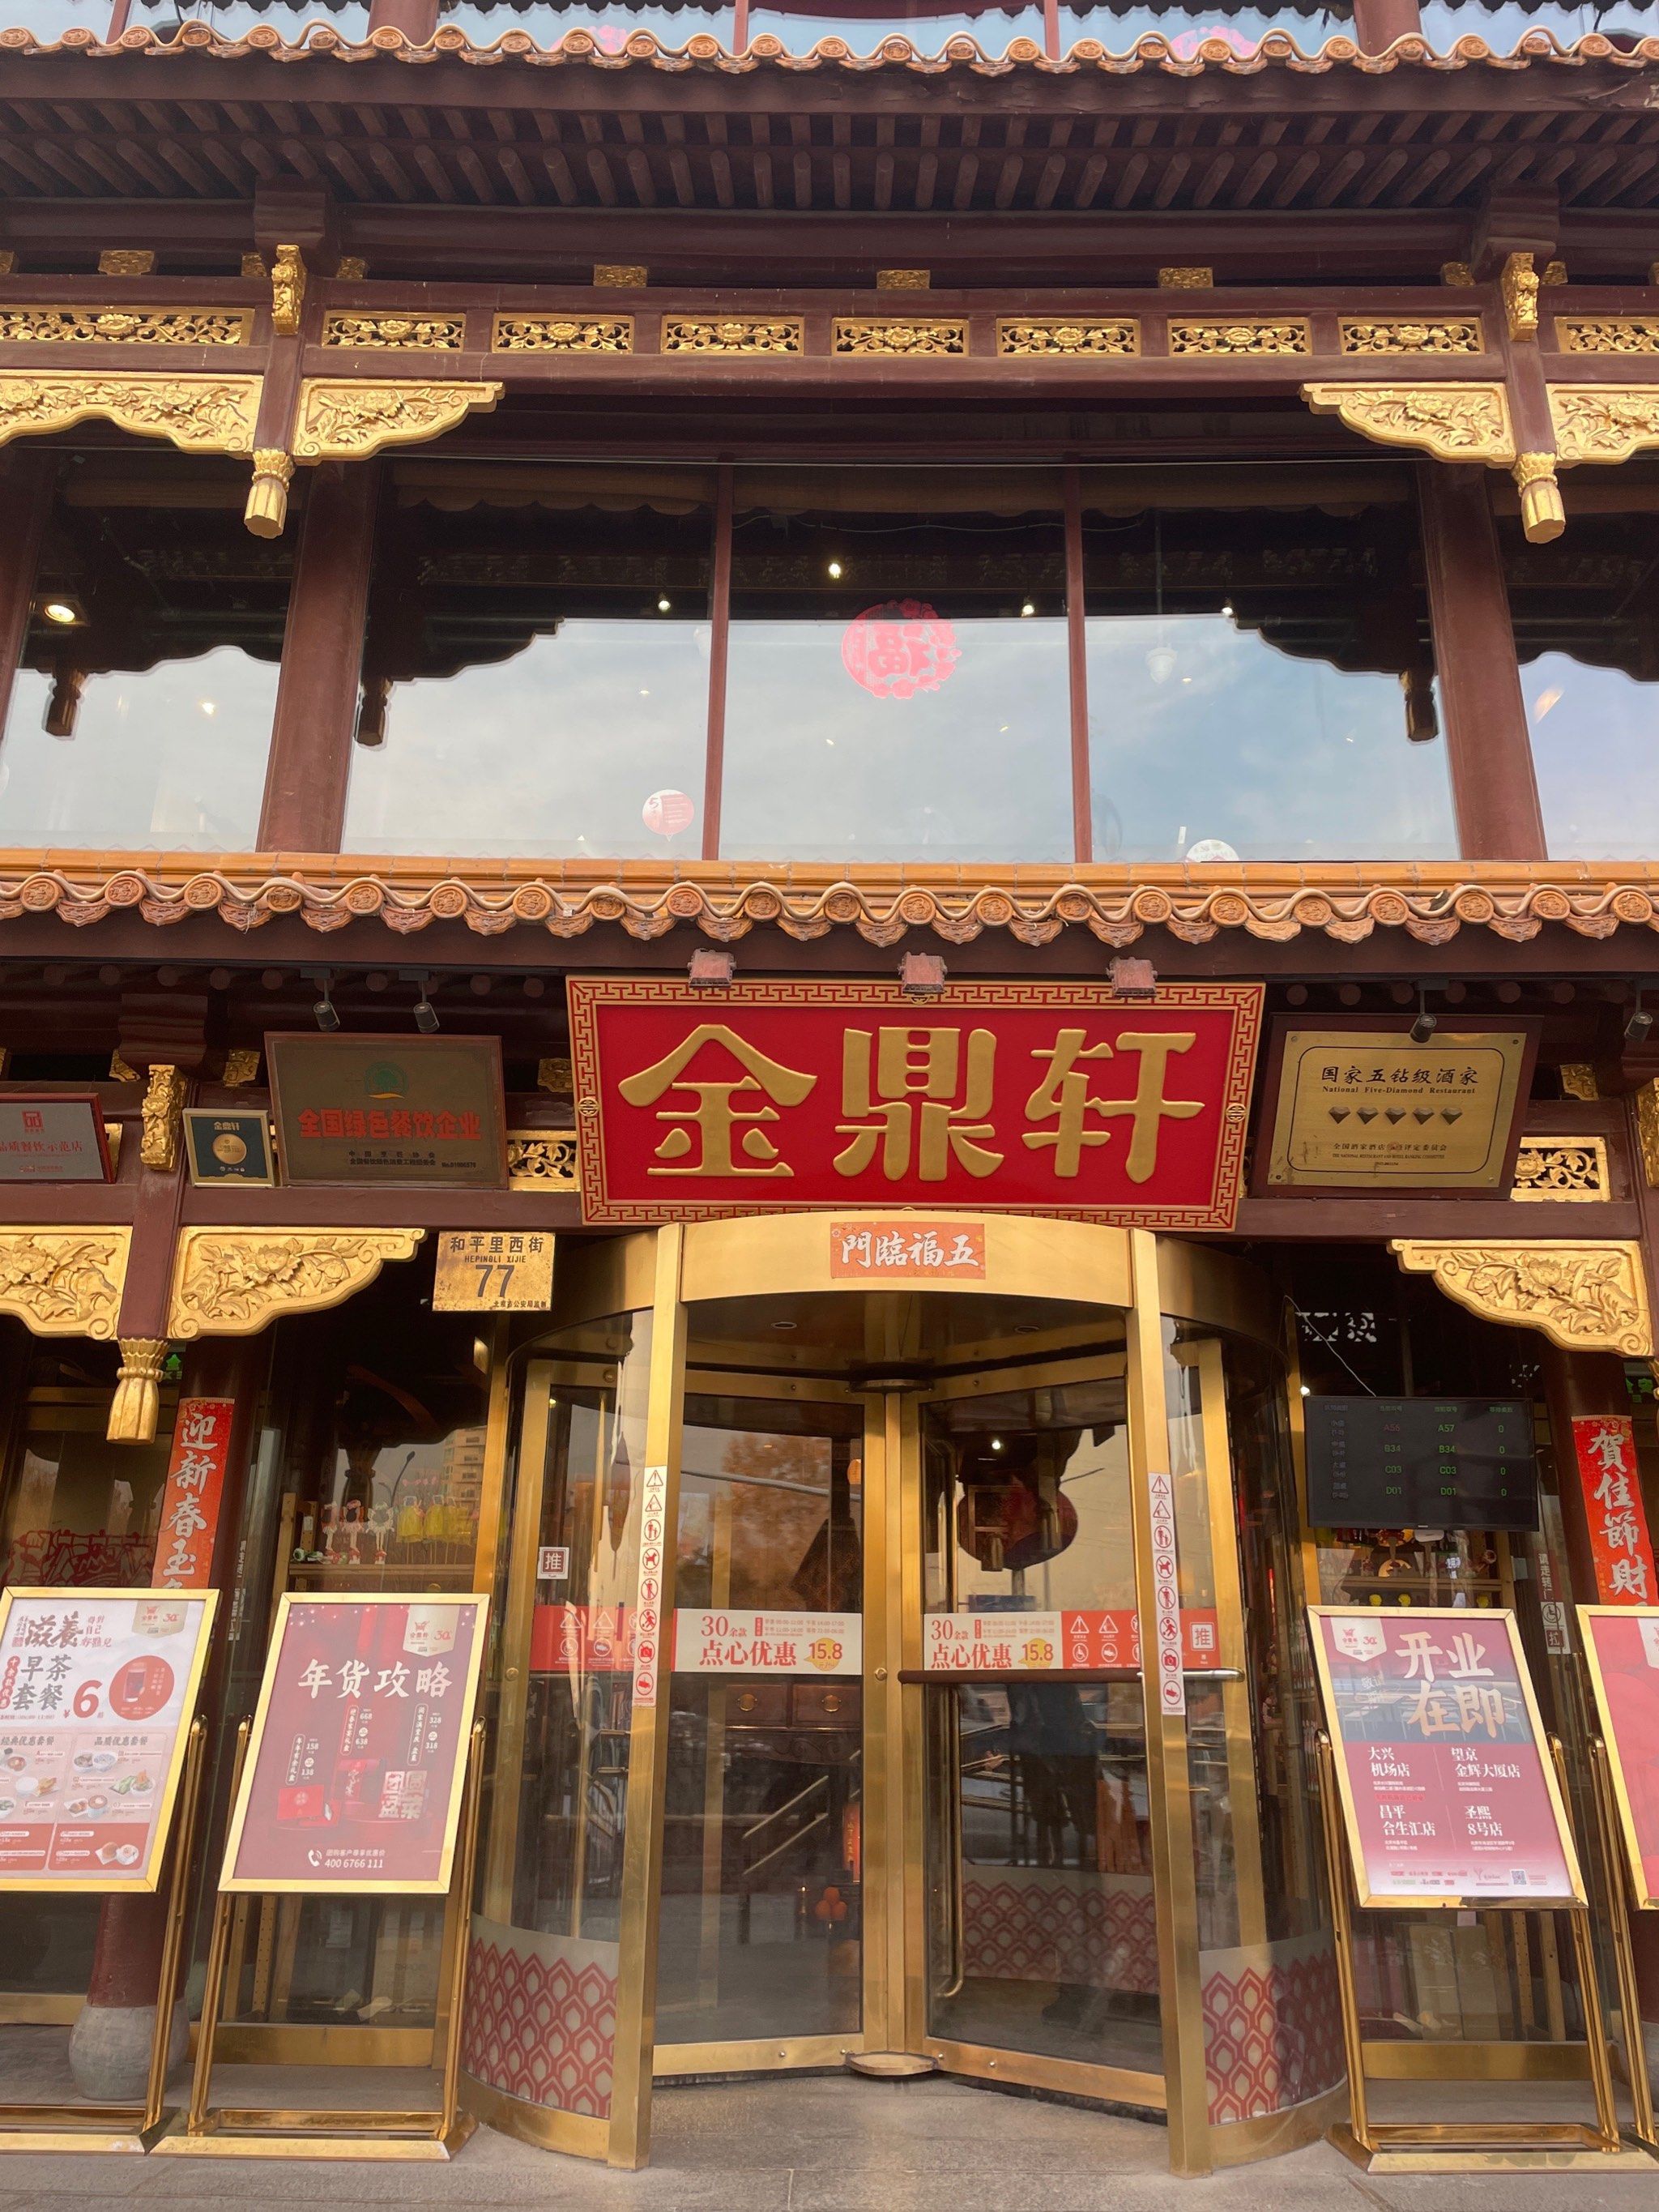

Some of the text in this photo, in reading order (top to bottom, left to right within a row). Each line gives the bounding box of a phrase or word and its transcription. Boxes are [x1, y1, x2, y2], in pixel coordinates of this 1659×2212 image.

[1321, 1065, 1479, 1085] 国家五钻级酒家
[618, 1023, 1205, 1184] 金鼎轩
[298, 1108, 481, 1140] 全国绿色餐饮企业
[450, 1236, 544, 1253] 和平里西街
[464, 1255, 527, 1263] HEPINGLI XIJIE
[476, 1264, 515, 1298] 77
[1438, 1424, 1455, 1433] A57
[1439, 1445, 1455, 1454] B34
[1384, 1465, 1402, 1474] C03
[1439, 1466, 1456, 1475] C03
[1386, 1486, 1402, 1495] D01
[1440, 1487, 1456, 1496] D01
[1587, 1428, 1648, 1606] 賀佳節財
[544, 1552, 562, 1570] 推
[701, 1616, 728, 1637] 30
[730, 1627, 747, 1638] 余款
[932, 1620, 953, 1640] 30
[1194, 1627, 1211, 1646] 推
[699, 1639, 797, 1667] 点心优惠
[808, 1642, 842, 1660] 15.8
[931, 1643, 1012, 1669] 点心优惠
[1022, 1643, 1053, 1661] 15.8
[1395, 1631, 1494, 1683] 开业
[20, 1655, 73, 1682] 早茶
[297, 1658, 453, 1700] 年货攻略
[12, 1683, 63, 1710] 套餐
[1406, 1680, 1507, 1738] 在即
[1368, 1746, 1395, 1761] 大兴
[1451, 1747, 1478, 1761] 望京
[1371, 1762, 1410, 1778] 机场店
[1455, 1763, 1520, 1779] 金辉大厦店
[1380, 1804, 1405, 1819] 昌平
[1465, 1805, 1492, 1820] 圣熙
[1383, 1821, 1436, 1837] 合生汇店
[1467, 1822, 1503, 1837] 8号店
[324, 1859, 383, 1868] 400 6766 111
